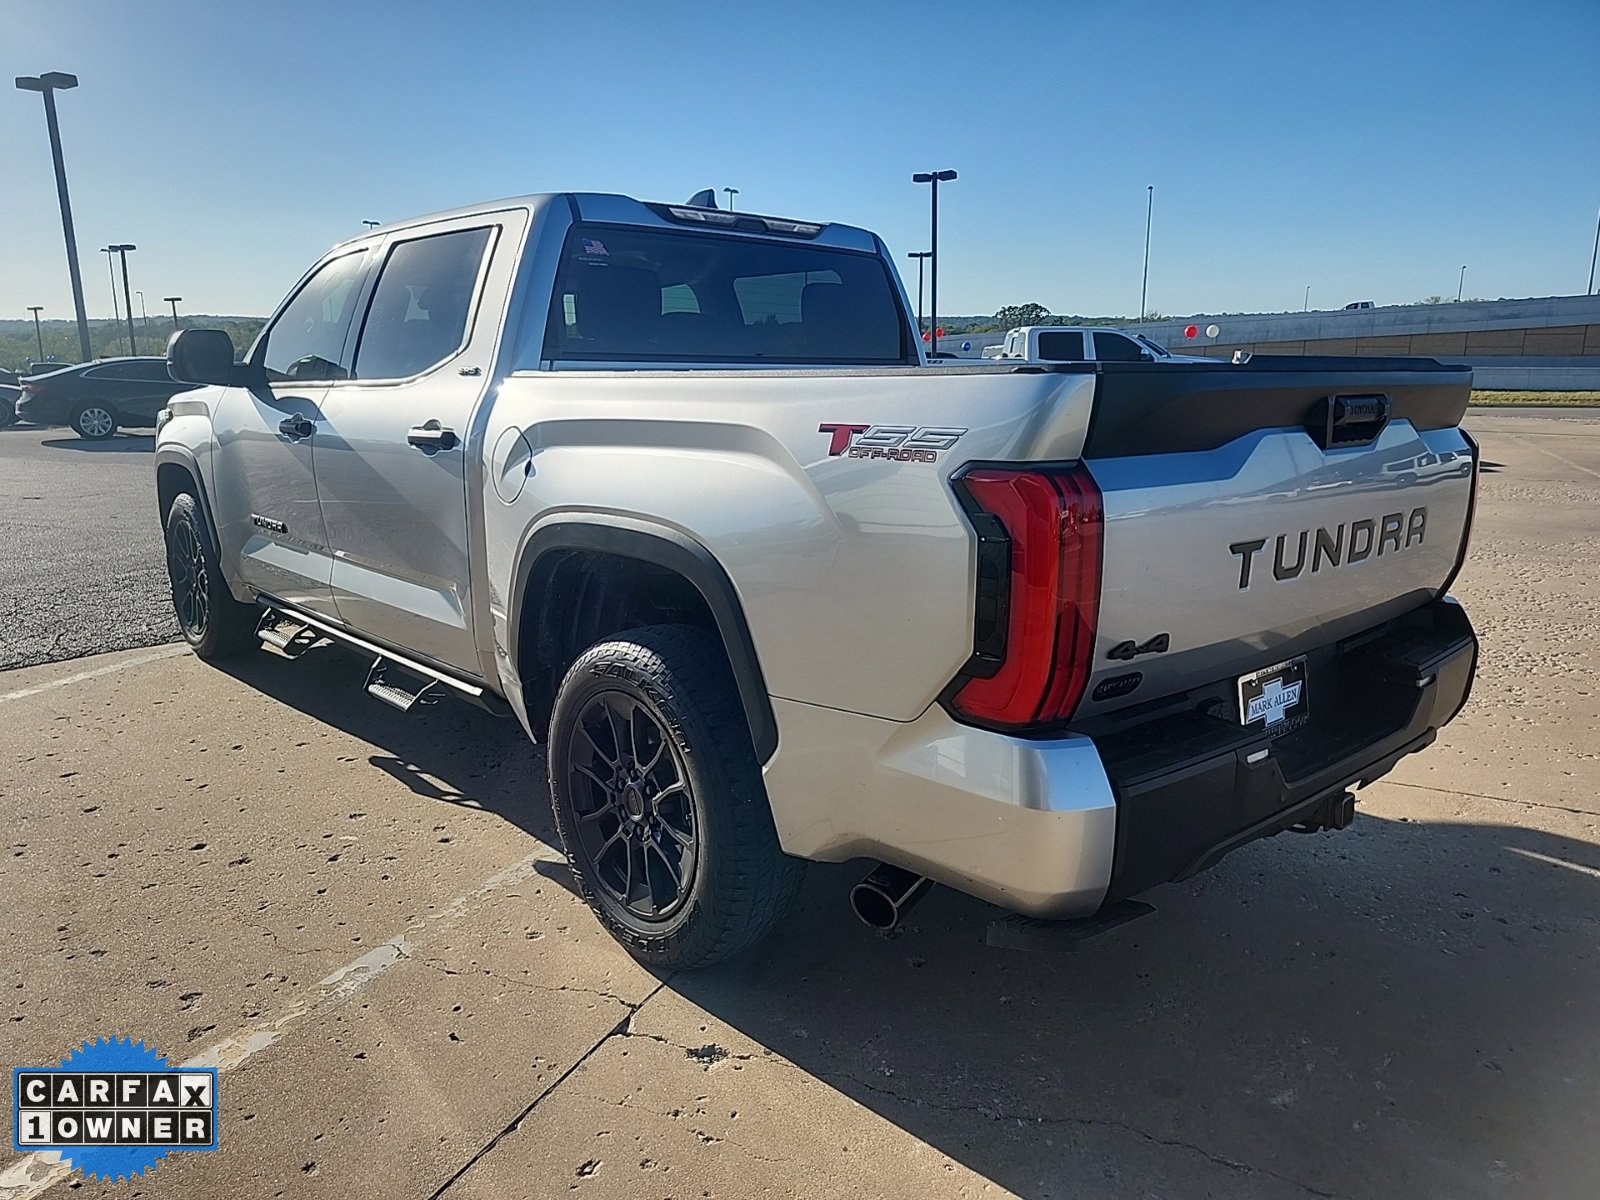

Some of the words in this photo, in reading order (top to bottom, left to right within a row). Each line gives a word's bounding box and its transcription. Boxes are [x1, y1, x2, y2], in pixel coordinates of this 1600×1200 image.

[849, 446, 937, 463] OFF-ROAD
[1228, 506, 1428, 591] TUNDRA
[1250, 696, 1273, 716] MARK
[1273, 688, 1298, 707] ALLEN
